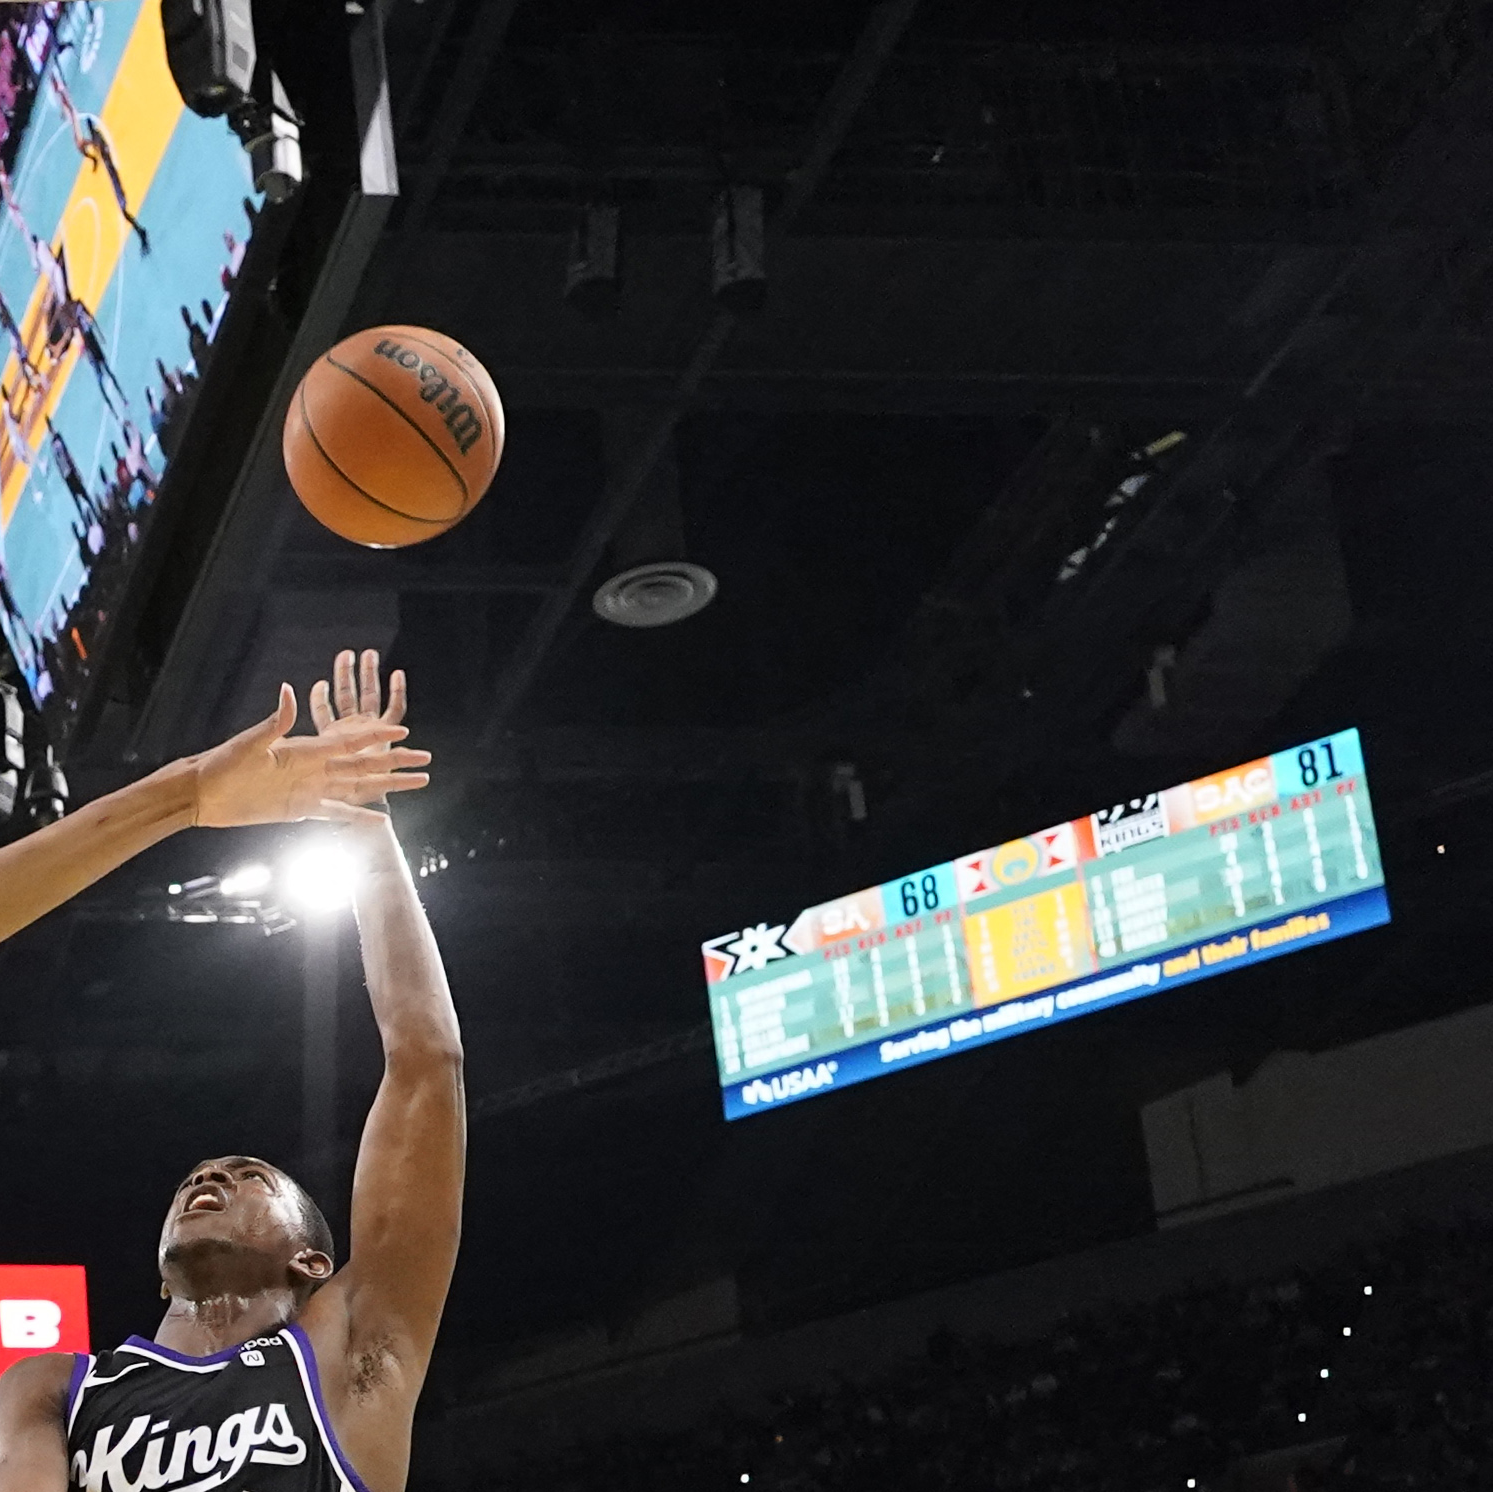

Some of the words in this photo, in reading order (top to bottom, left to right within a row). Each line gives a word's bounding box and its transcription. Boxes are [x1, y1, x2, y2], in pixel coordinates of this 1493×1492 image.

[1298, 742, 1342, 787] 81
[1196, 768, 1270, 812] SAC
[900, 874, 939, 917] 68
[821, 902, 870, 934] SA
